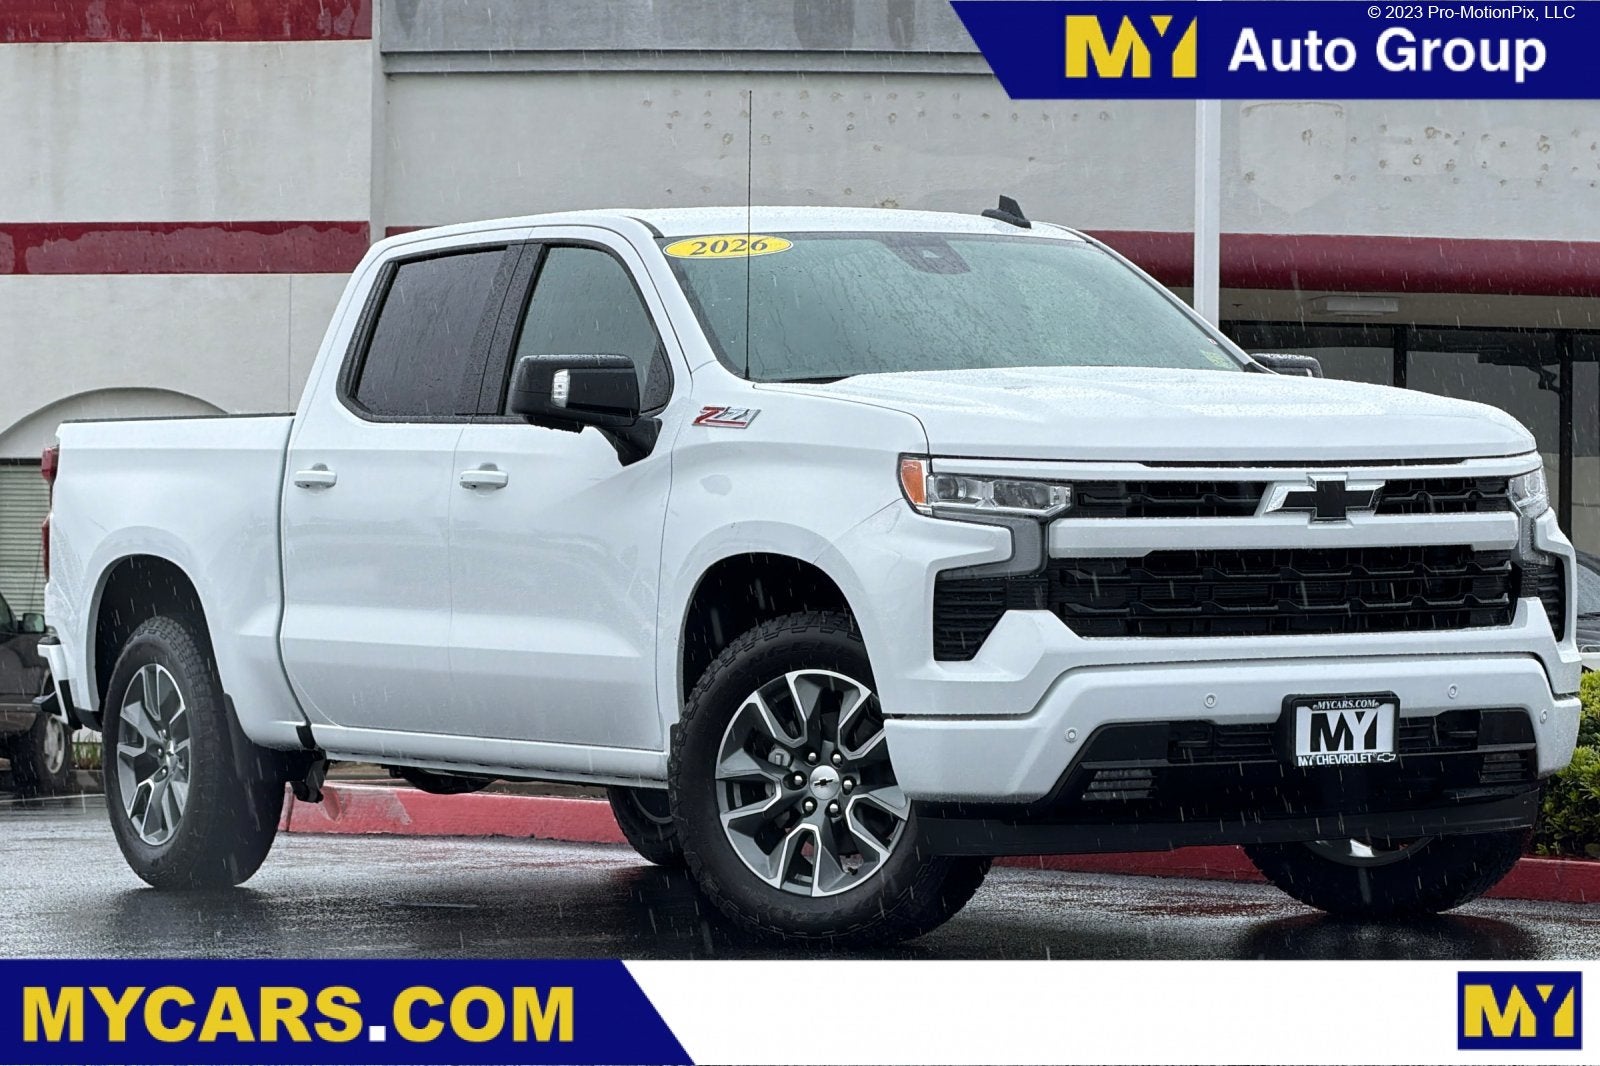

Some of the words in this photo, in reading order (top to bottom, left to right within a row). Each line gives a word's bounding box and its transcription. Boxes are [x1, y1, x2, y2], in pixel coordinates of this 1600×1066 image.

[690, 237, 769, 256] 2026
[1317, 699, 1376, 710] MYCARS.COM
[1309, 711, 1378, 752] MY
[1316, 753, 1371, 765] CHEVROLET
